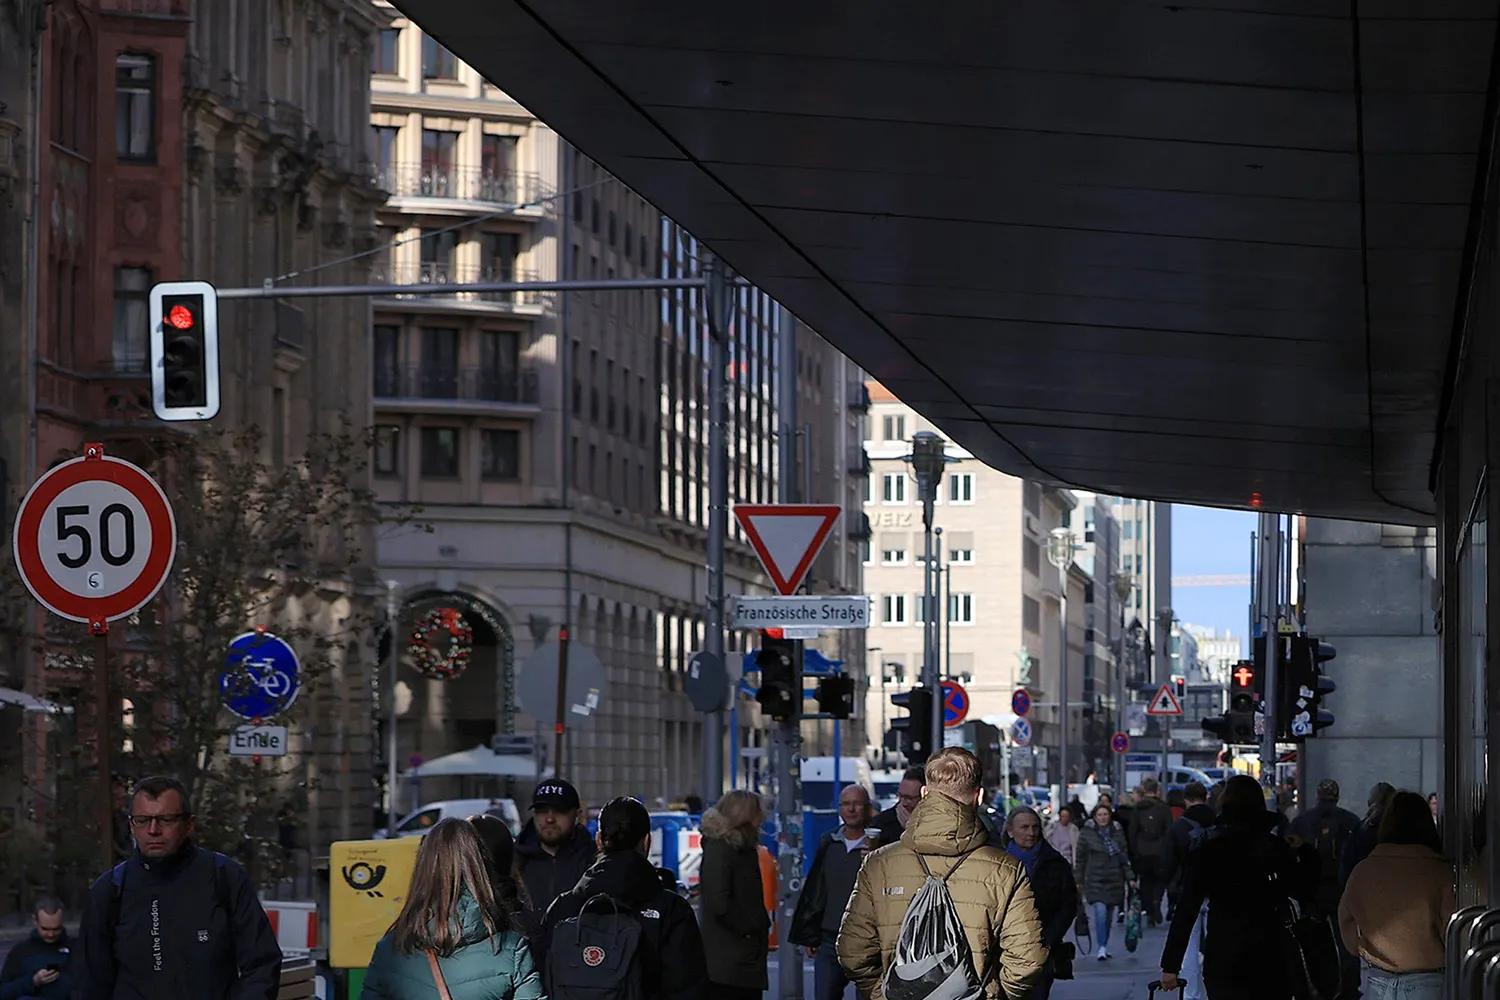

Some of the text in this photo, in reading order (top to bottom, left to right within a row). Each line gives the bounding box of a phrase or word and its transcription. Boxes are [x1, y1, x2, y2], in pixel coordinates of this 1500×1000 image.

[57, 504, 134, 568] 50
[736, 604, 864, 622] Französische Straße
[236, 731, 279, 748] Ende
[150, 899, 163, 971] Feel the Freedom
